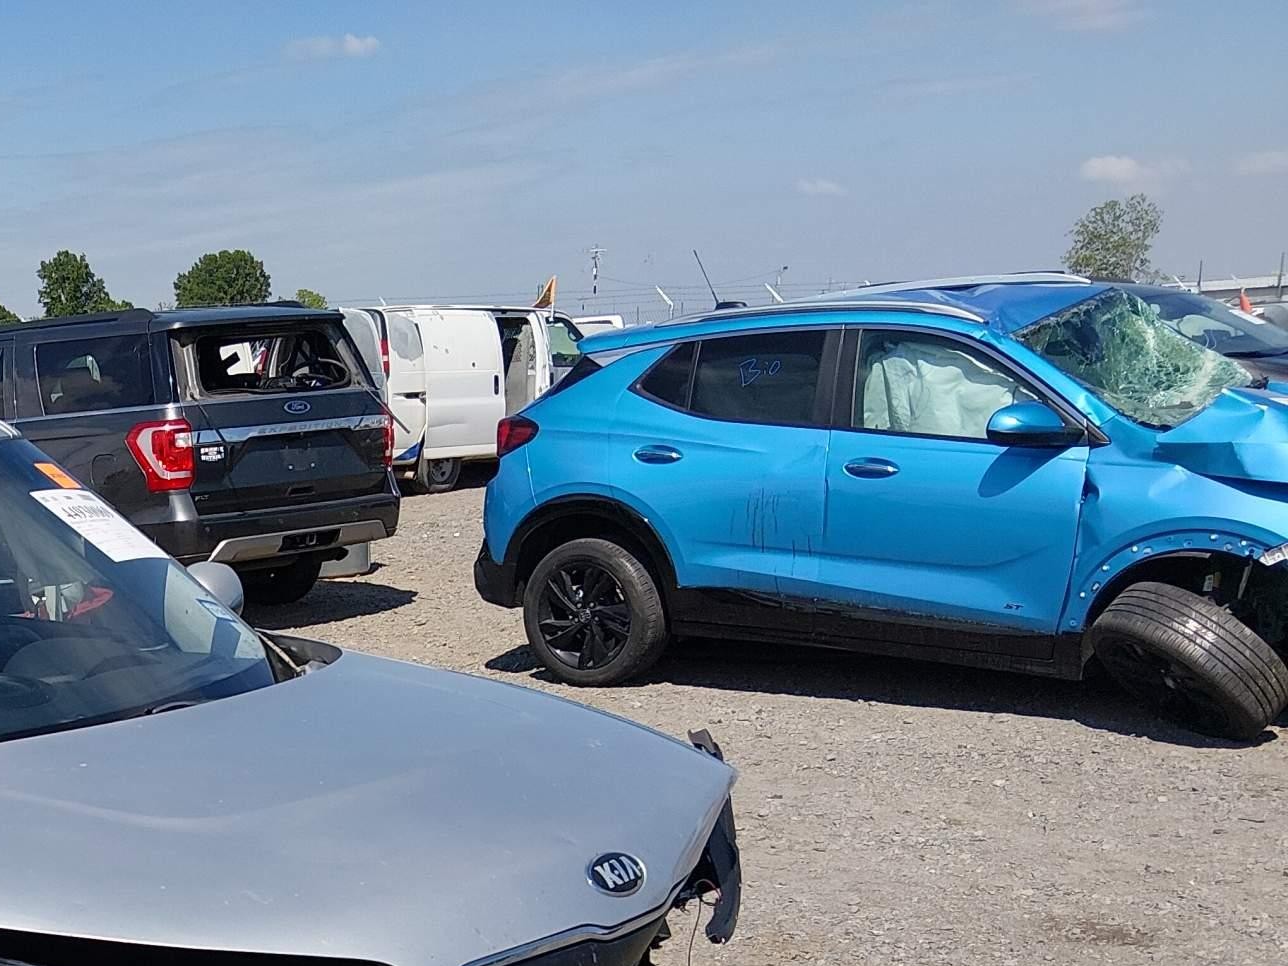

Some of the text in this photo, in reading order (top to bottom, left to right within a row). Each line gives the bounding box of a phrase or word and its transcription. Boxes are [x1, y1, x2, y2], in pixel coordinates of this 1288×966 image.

[257, 421, 344, 434] EXPEDITION
[61, 504, 114, 520] 4493
[593, 855, 642, 889] KIA
